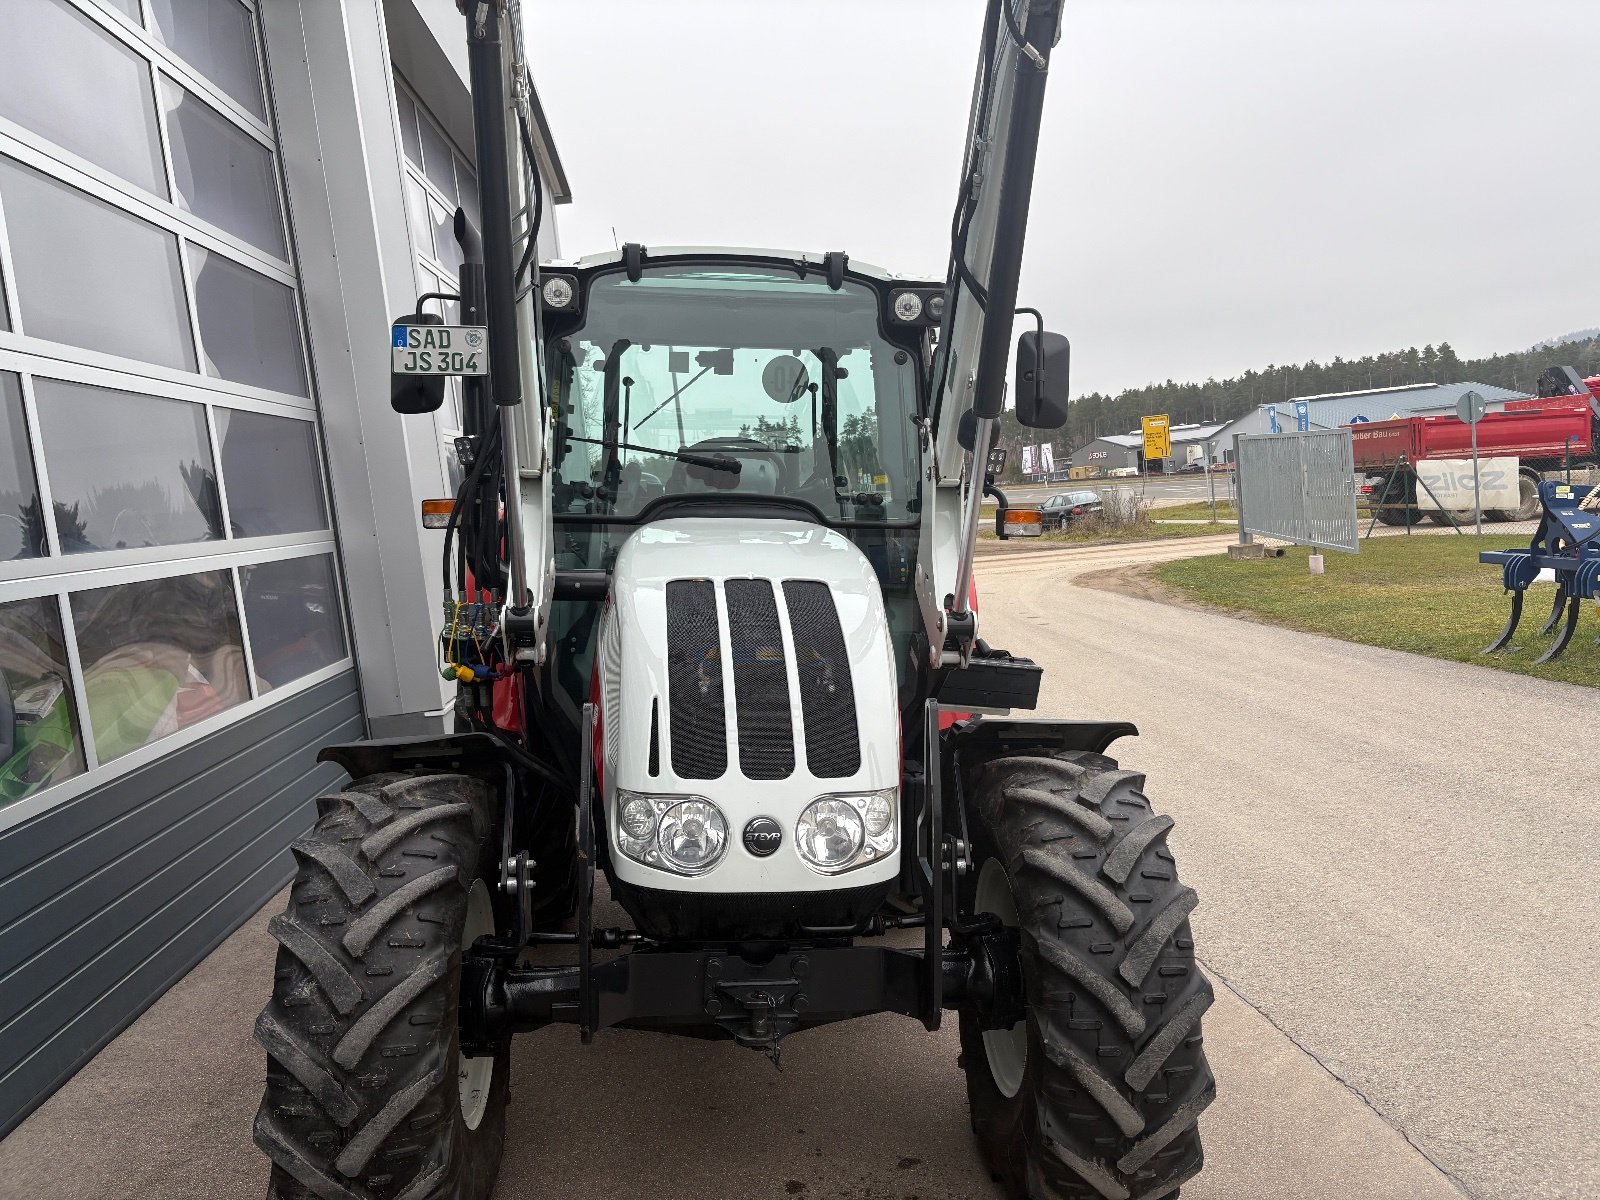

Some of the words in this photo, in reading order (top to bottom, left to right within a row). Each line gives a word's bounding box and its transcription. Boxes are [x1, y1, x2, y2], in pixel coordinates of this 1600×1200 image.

[408, 329, 451, 349] SAD
[404, 352, 432, 371] JS
[437, 352, 478, 372] 304
[744, 832, 780, 840] STEYR
